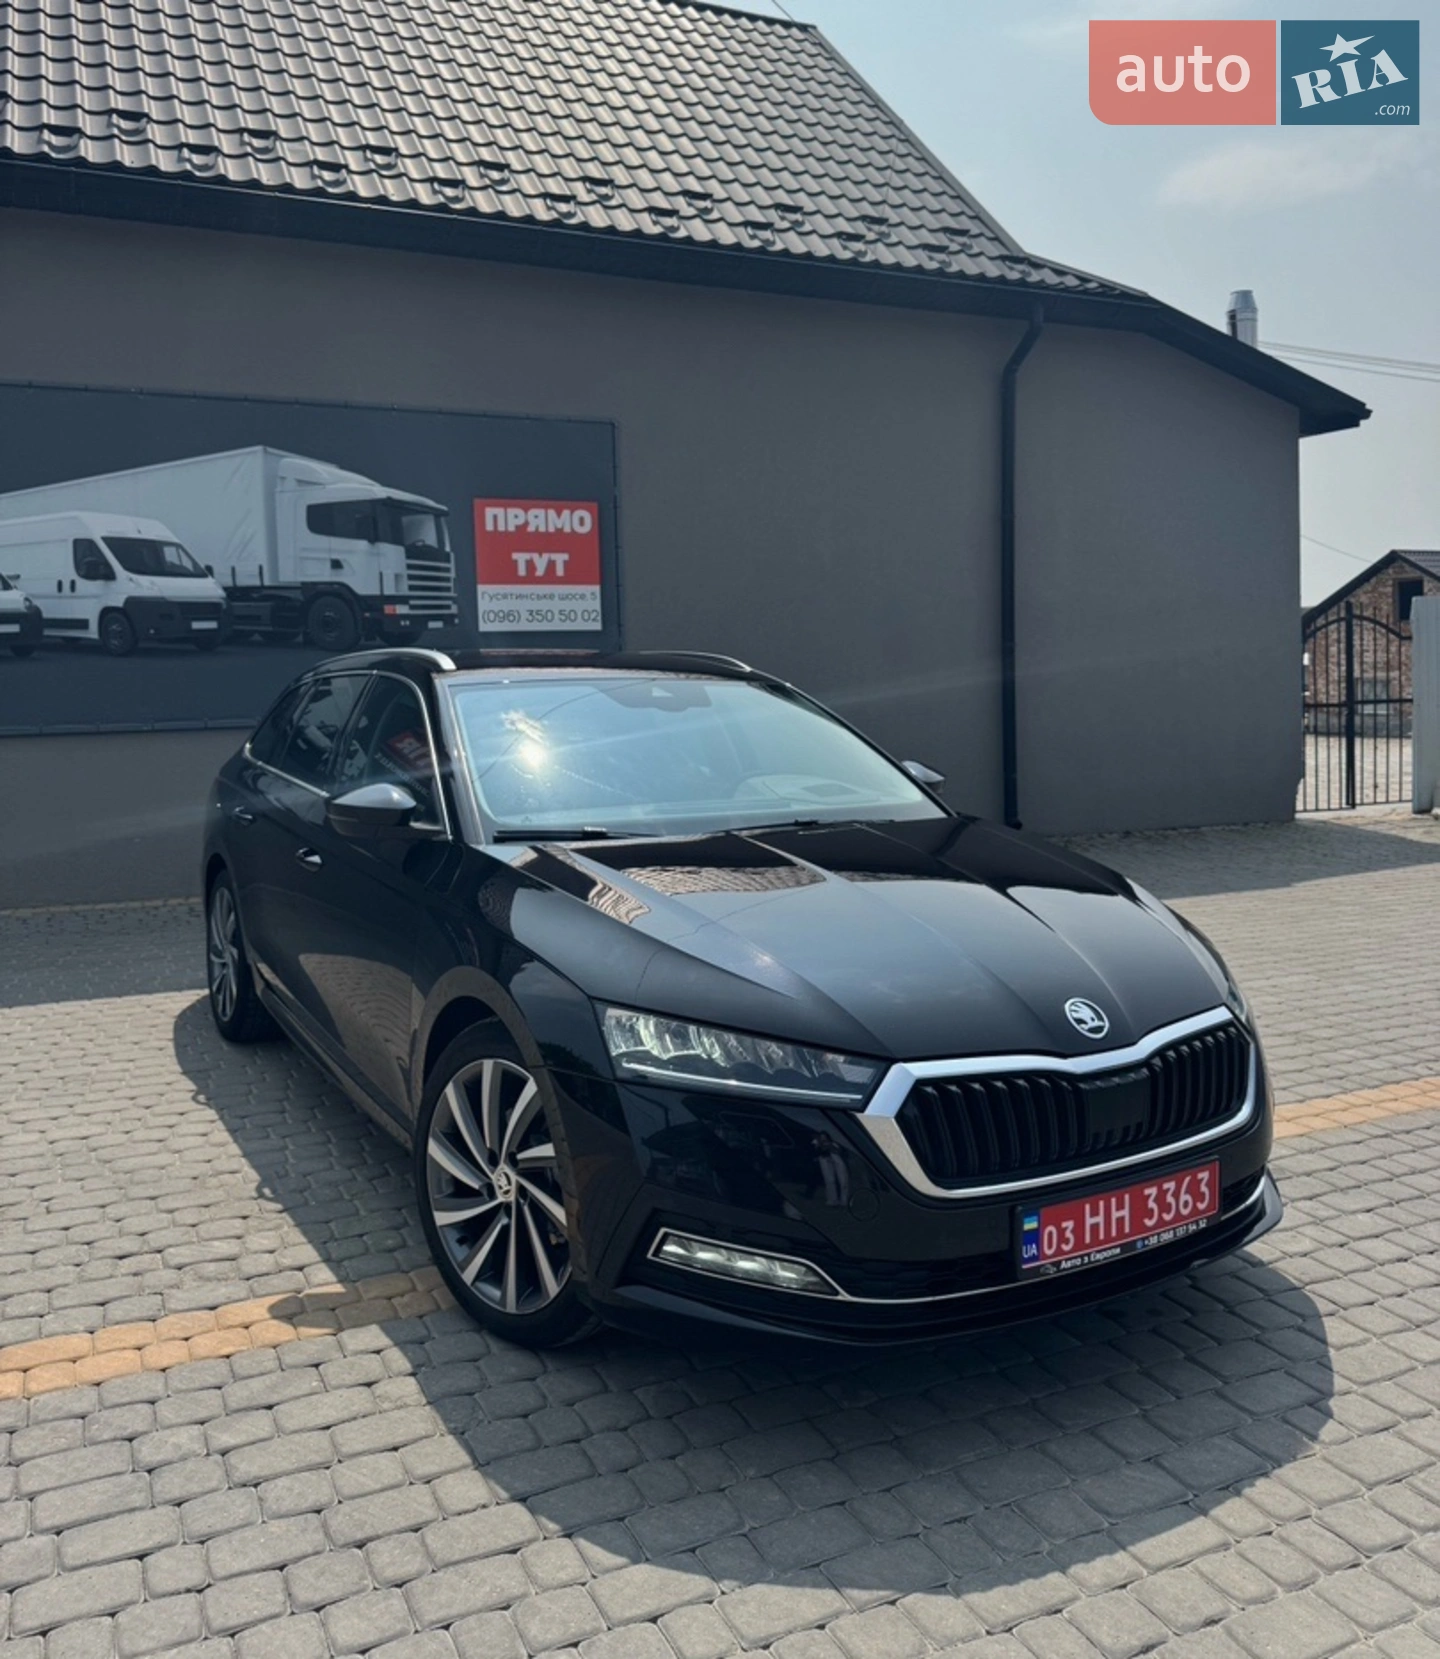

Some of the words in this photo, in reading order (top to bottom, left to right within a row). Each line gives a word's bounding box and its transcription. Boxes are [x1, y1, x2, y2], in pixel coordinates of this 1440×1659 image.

[484, 506, 593, 534] ПРЯМО
[511, 552, 570, 577] ТУТ
[481, 590, 556, 603] Гусятинське
[481, 608, 522, 625] (096)
[525, 608, 555, 623] 350
[558, 608, 578, 623] 50
[581, 608, 600, 623] 02
[1042, 1219, 1075, 1256] 03
[1084, 1193, 1131, 1244] HH
[1143, 1170, 1211, 1227] 3363
[1022, 1243, 1038, 1259] UA
[1060, 1256, 1082, 1270] Авто
